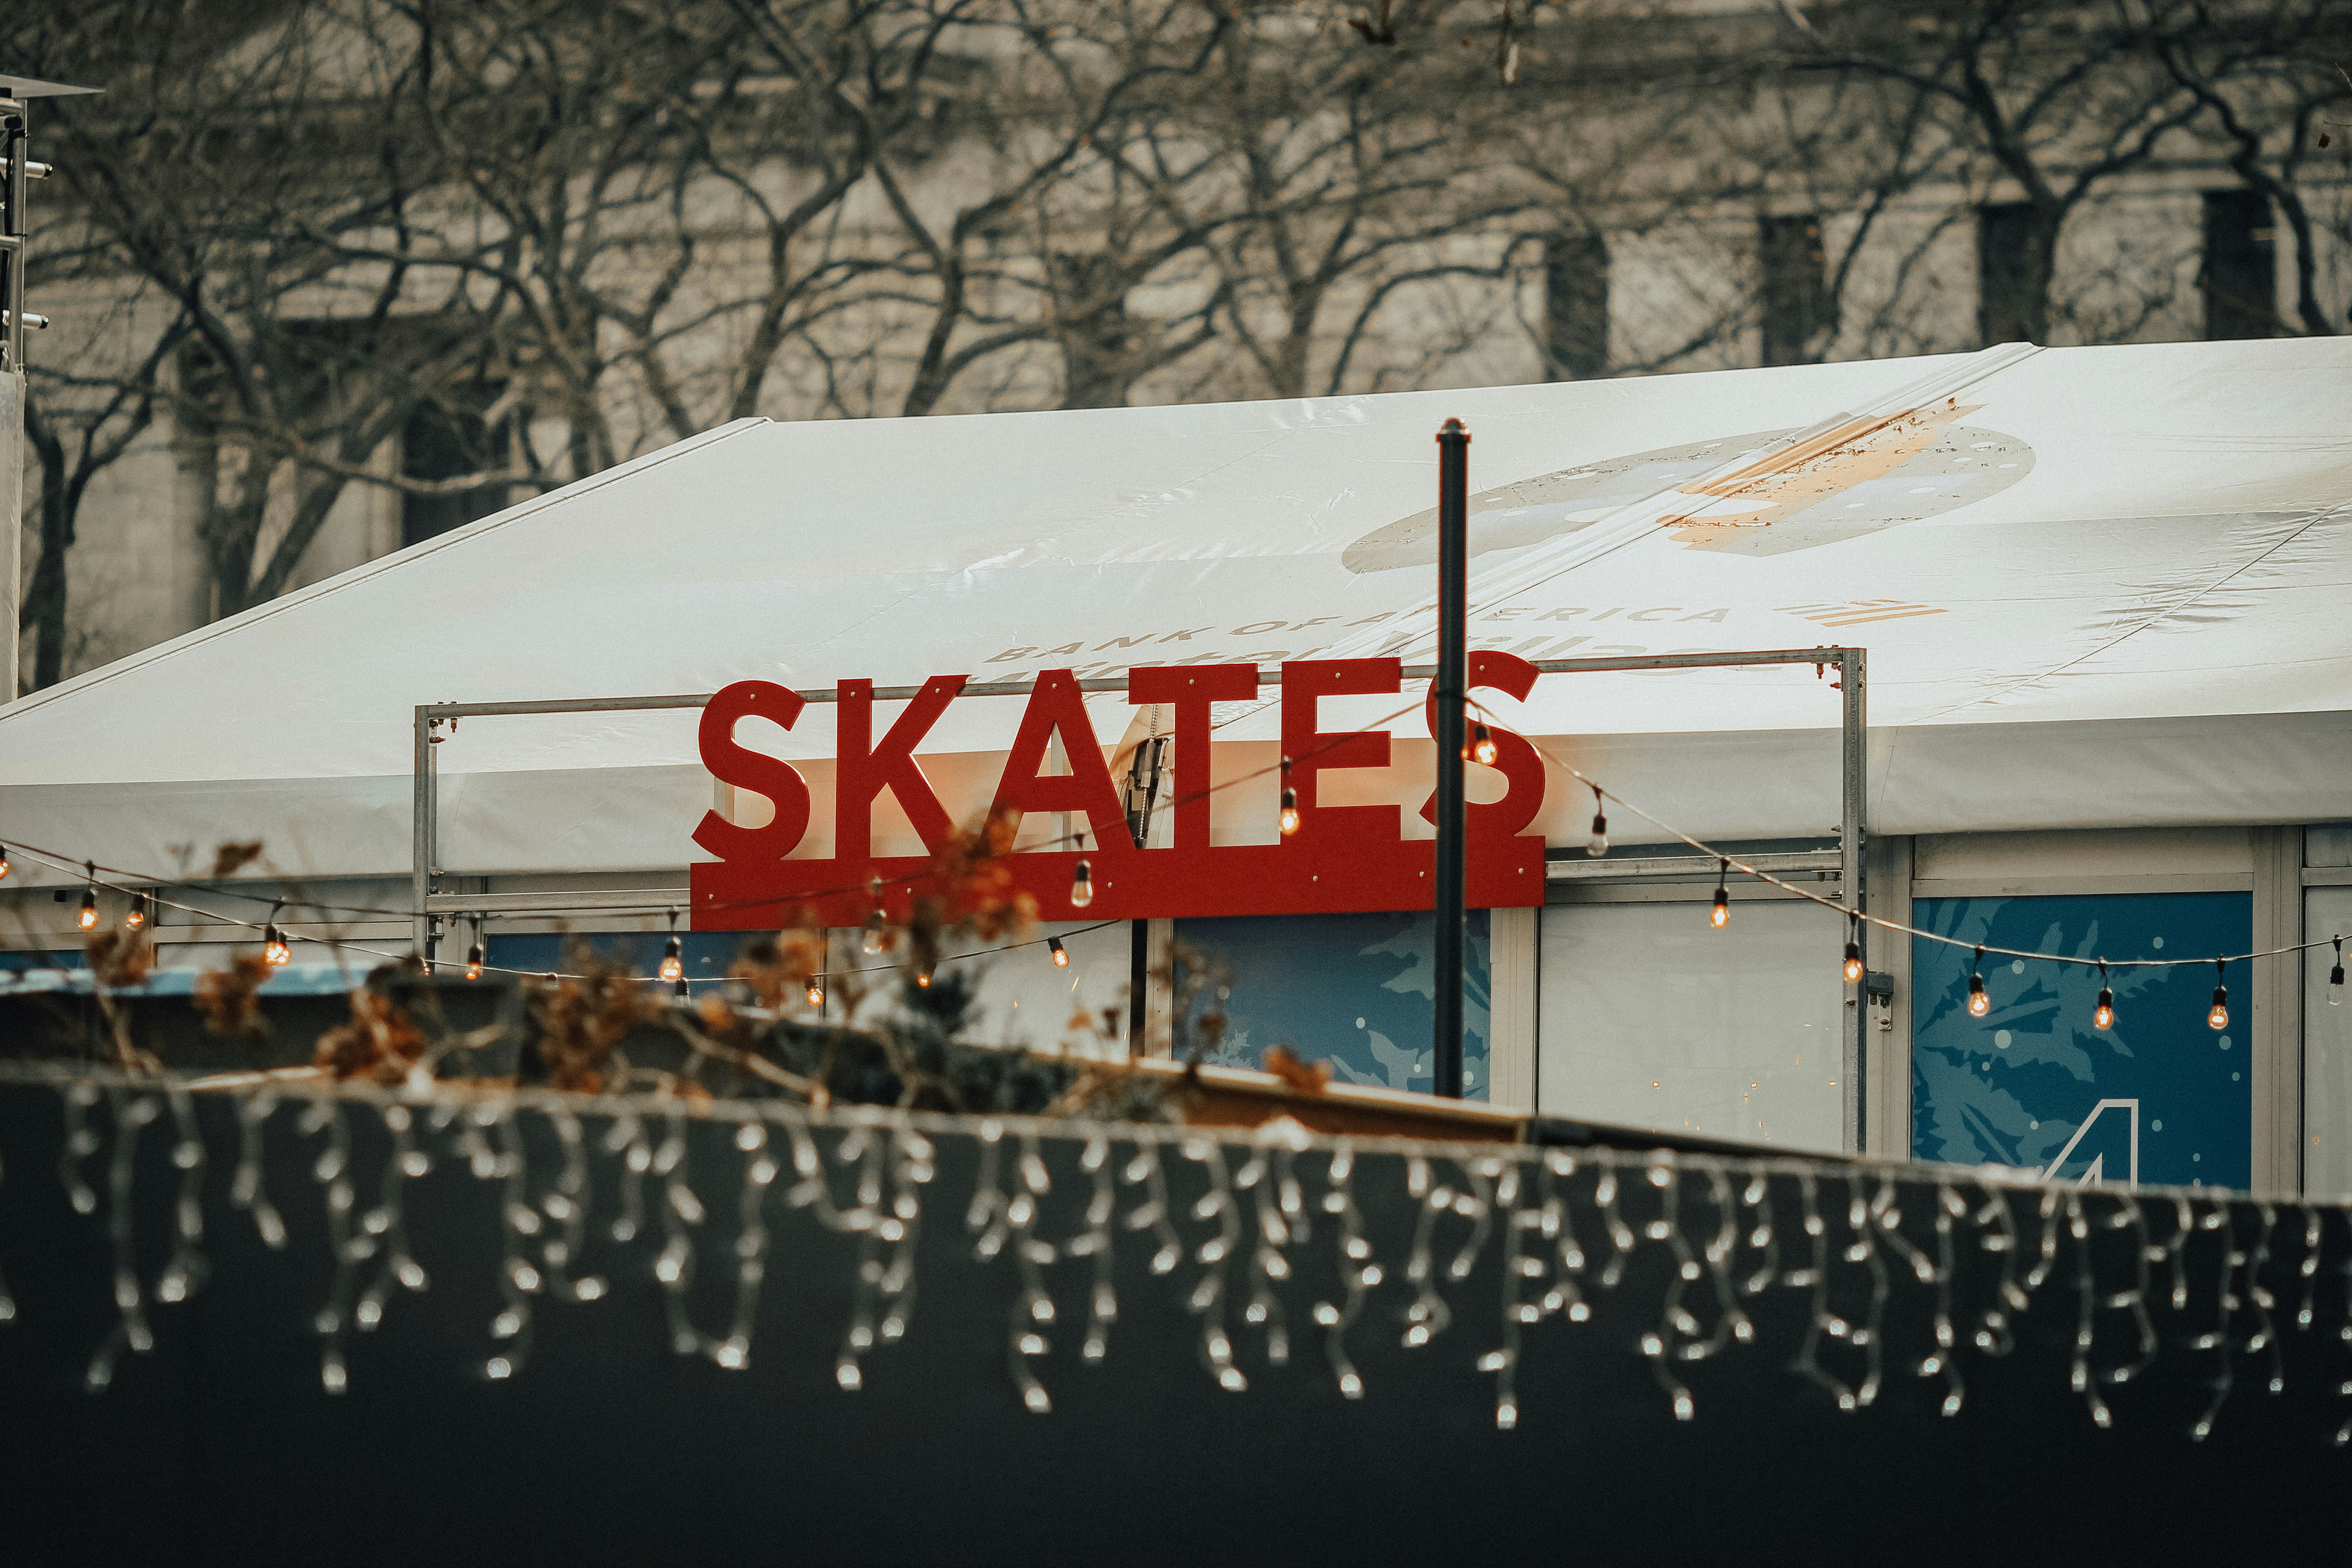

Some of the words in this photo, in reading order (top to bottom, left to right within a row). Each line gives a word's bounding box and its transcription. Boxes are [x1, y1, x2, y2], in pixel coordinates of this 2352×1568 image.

[981, 626, 1218, 663] BANK
[1228, 615, 1344, 636] OF
[691, 650, 1546, 861] SKATES
